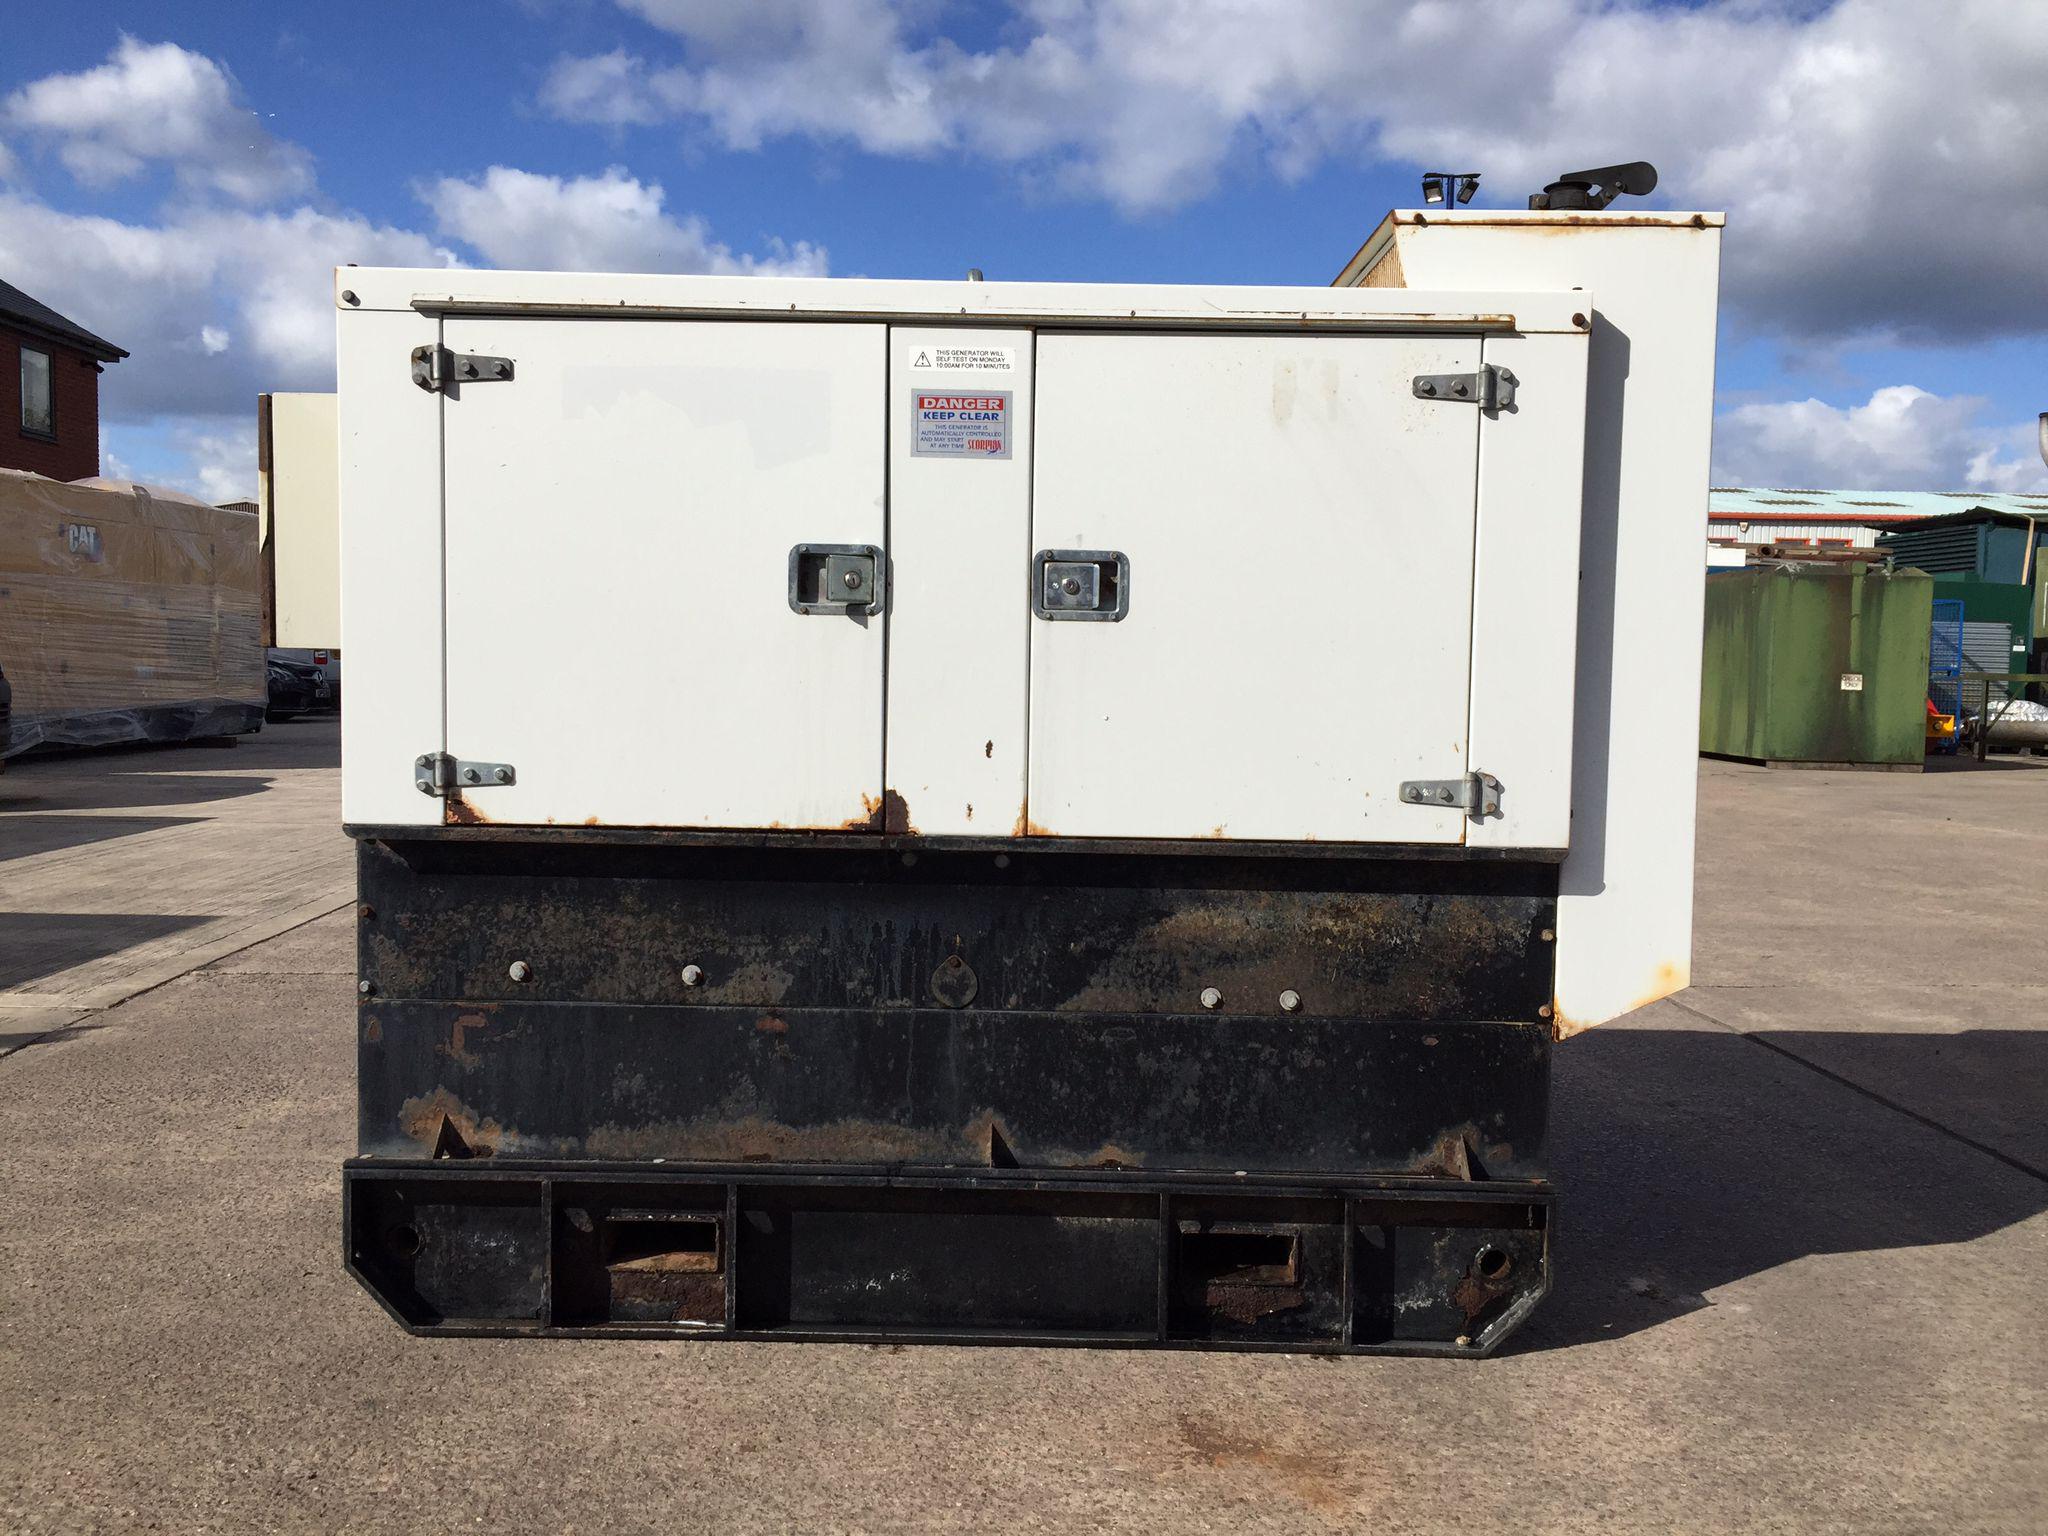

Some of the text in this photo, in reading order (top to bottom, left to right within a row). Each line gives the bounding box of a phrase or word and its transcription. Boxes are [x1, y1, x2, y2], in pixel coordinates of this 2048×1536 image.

[923, 398, 1000, 409] DANGER
[923, 411, 999, 420] KEEP CLEAR
[69, 524, 96, 554] CAT
